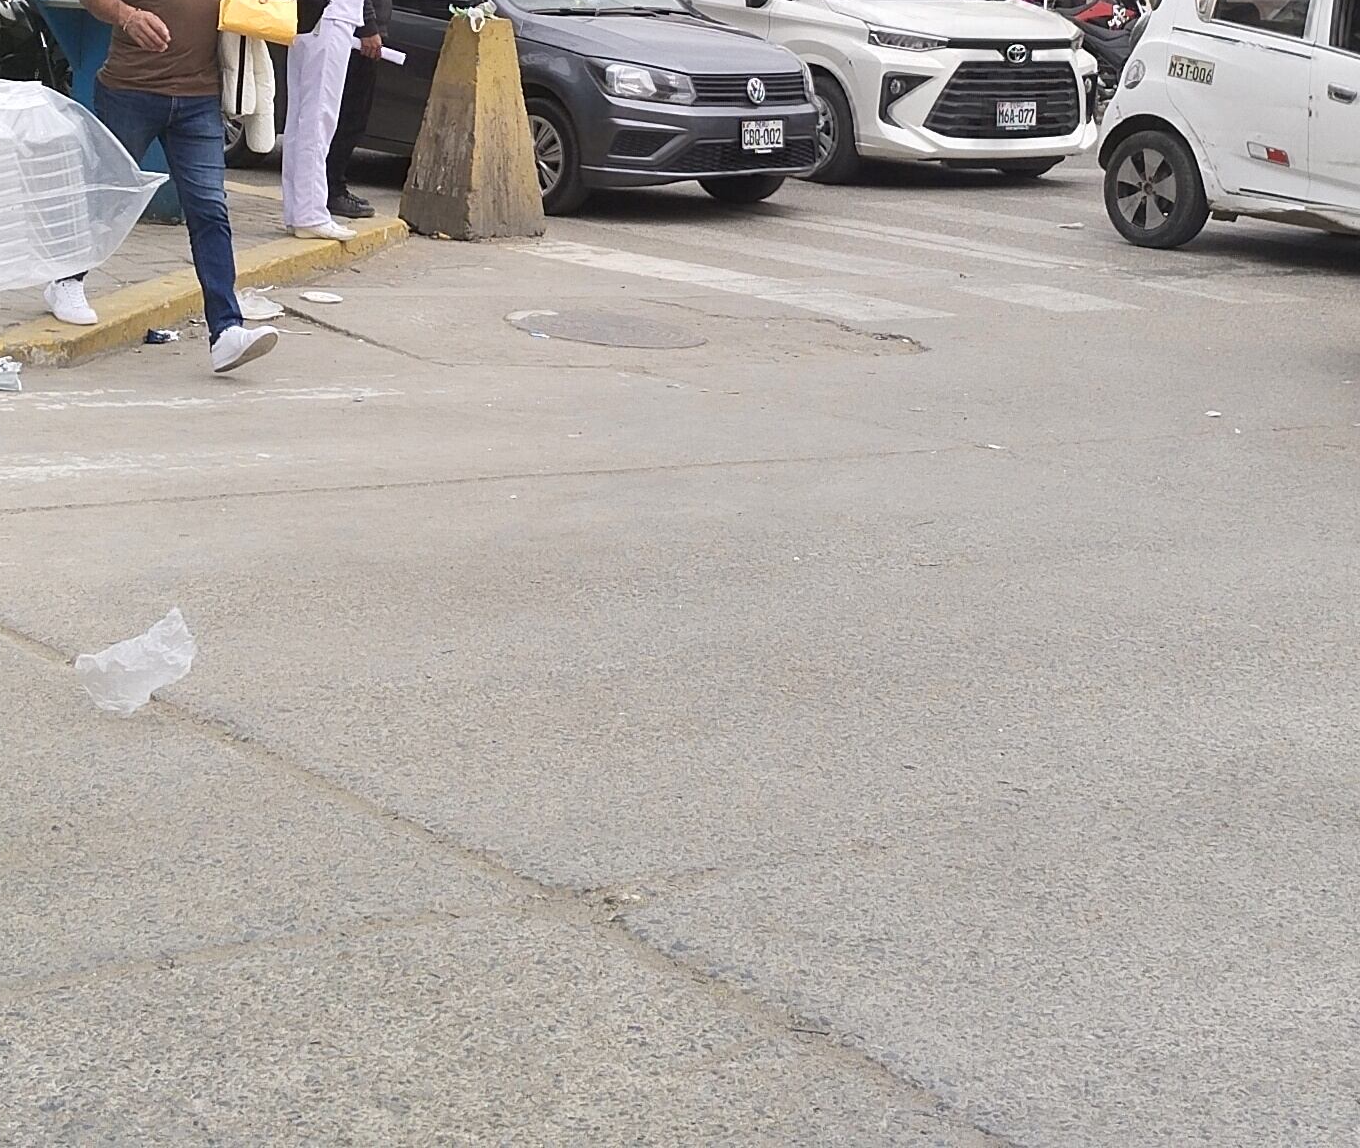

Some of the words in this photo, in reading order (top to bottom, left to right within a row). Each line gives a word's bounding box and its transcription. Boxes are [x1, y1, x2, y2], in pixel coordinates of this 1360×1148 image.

[1168, 60, 1213, 85] M3T-006
[999, 108, 1035, 124] M6A-077
[743, 128, 782, 146] CBQ-002
